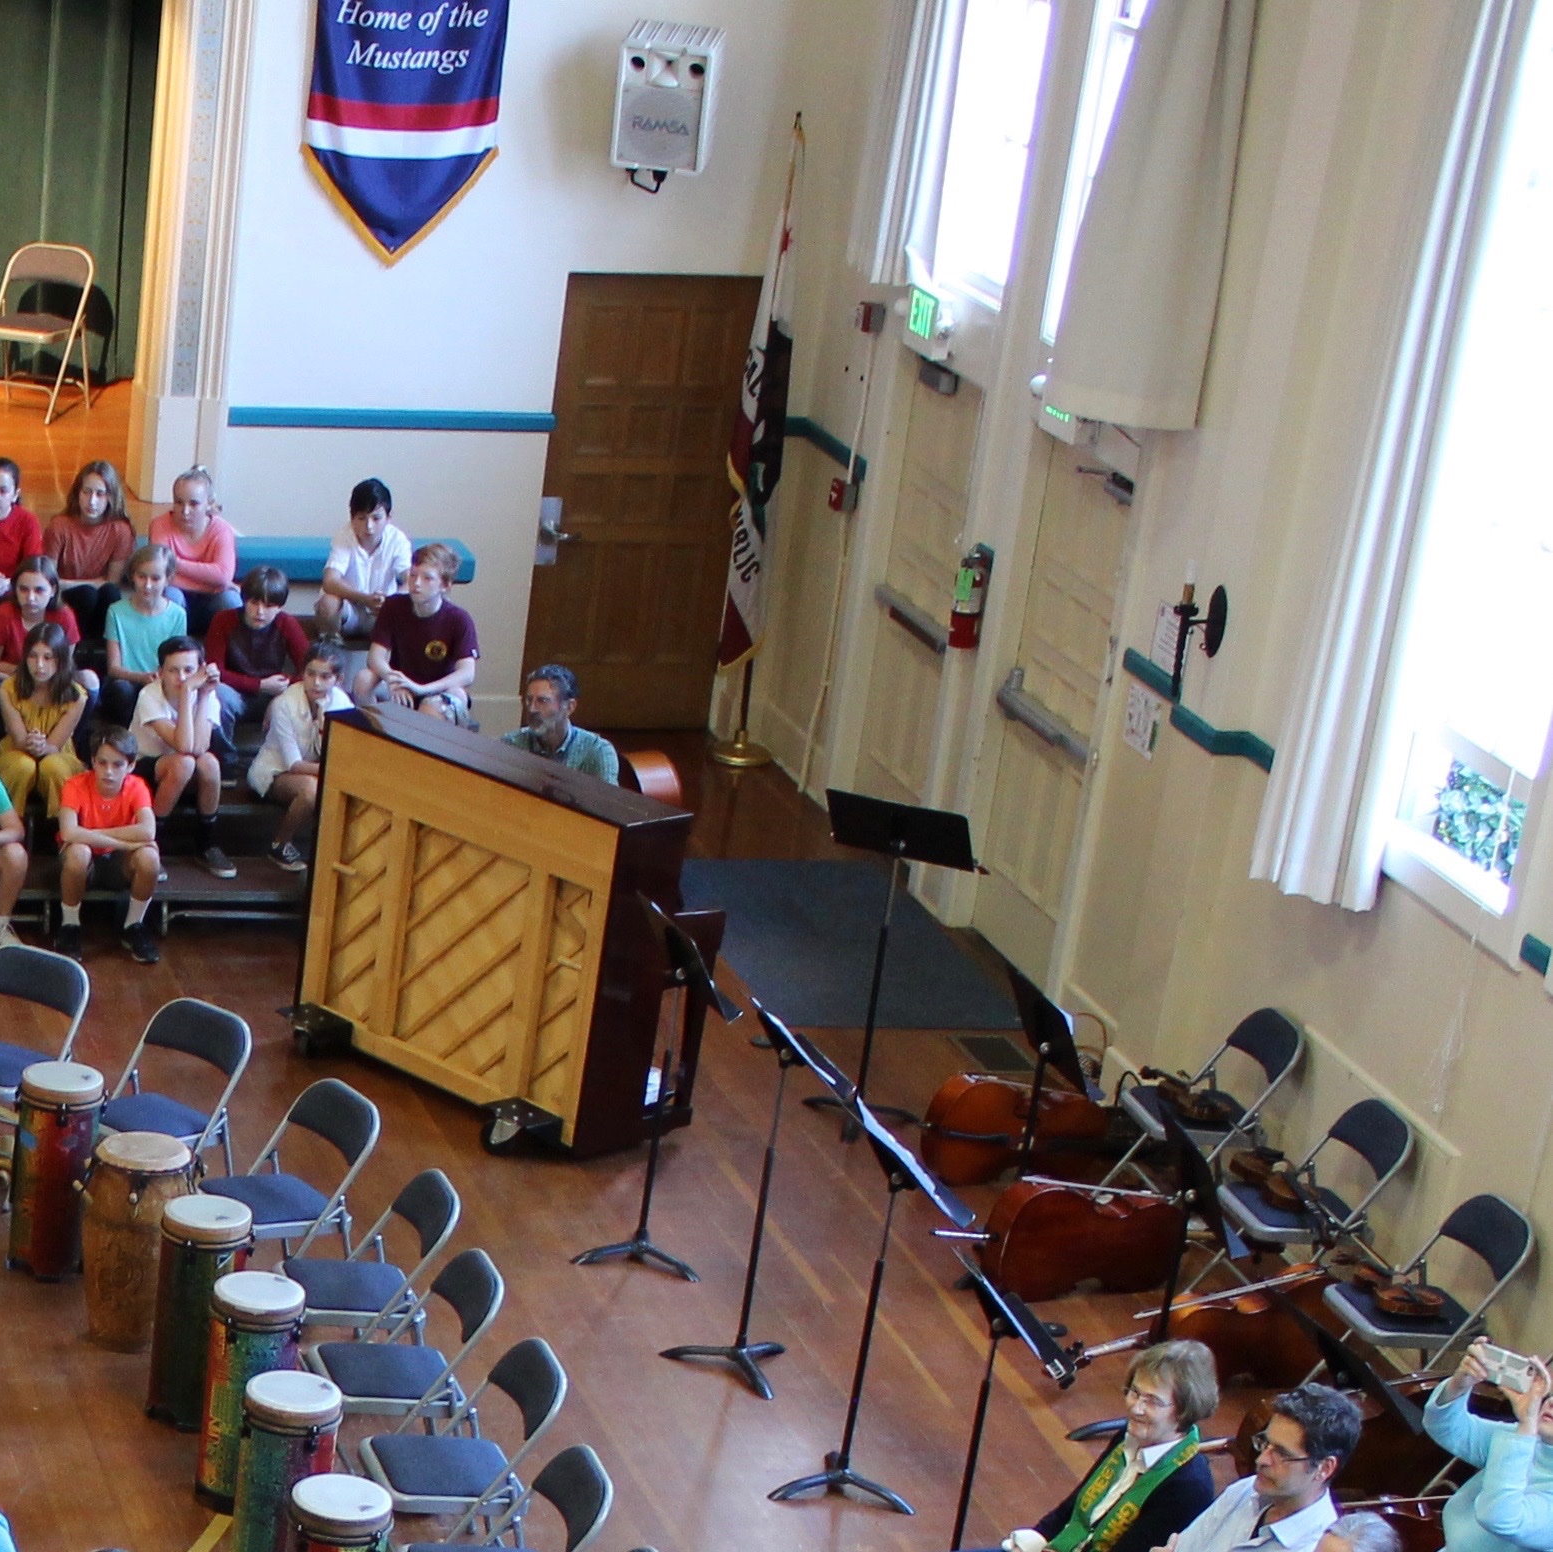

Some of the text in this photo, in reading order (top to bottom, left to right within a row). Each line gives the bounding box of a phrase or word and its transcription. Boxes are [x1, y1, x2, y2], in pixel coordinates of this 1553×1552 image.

[336, 0, 489, 36] Home of the
[346, 40, 470, 74] Mustangs
[632, 115, 689, 136] RAMSA
[907, 289, 935, 340] EXIT
